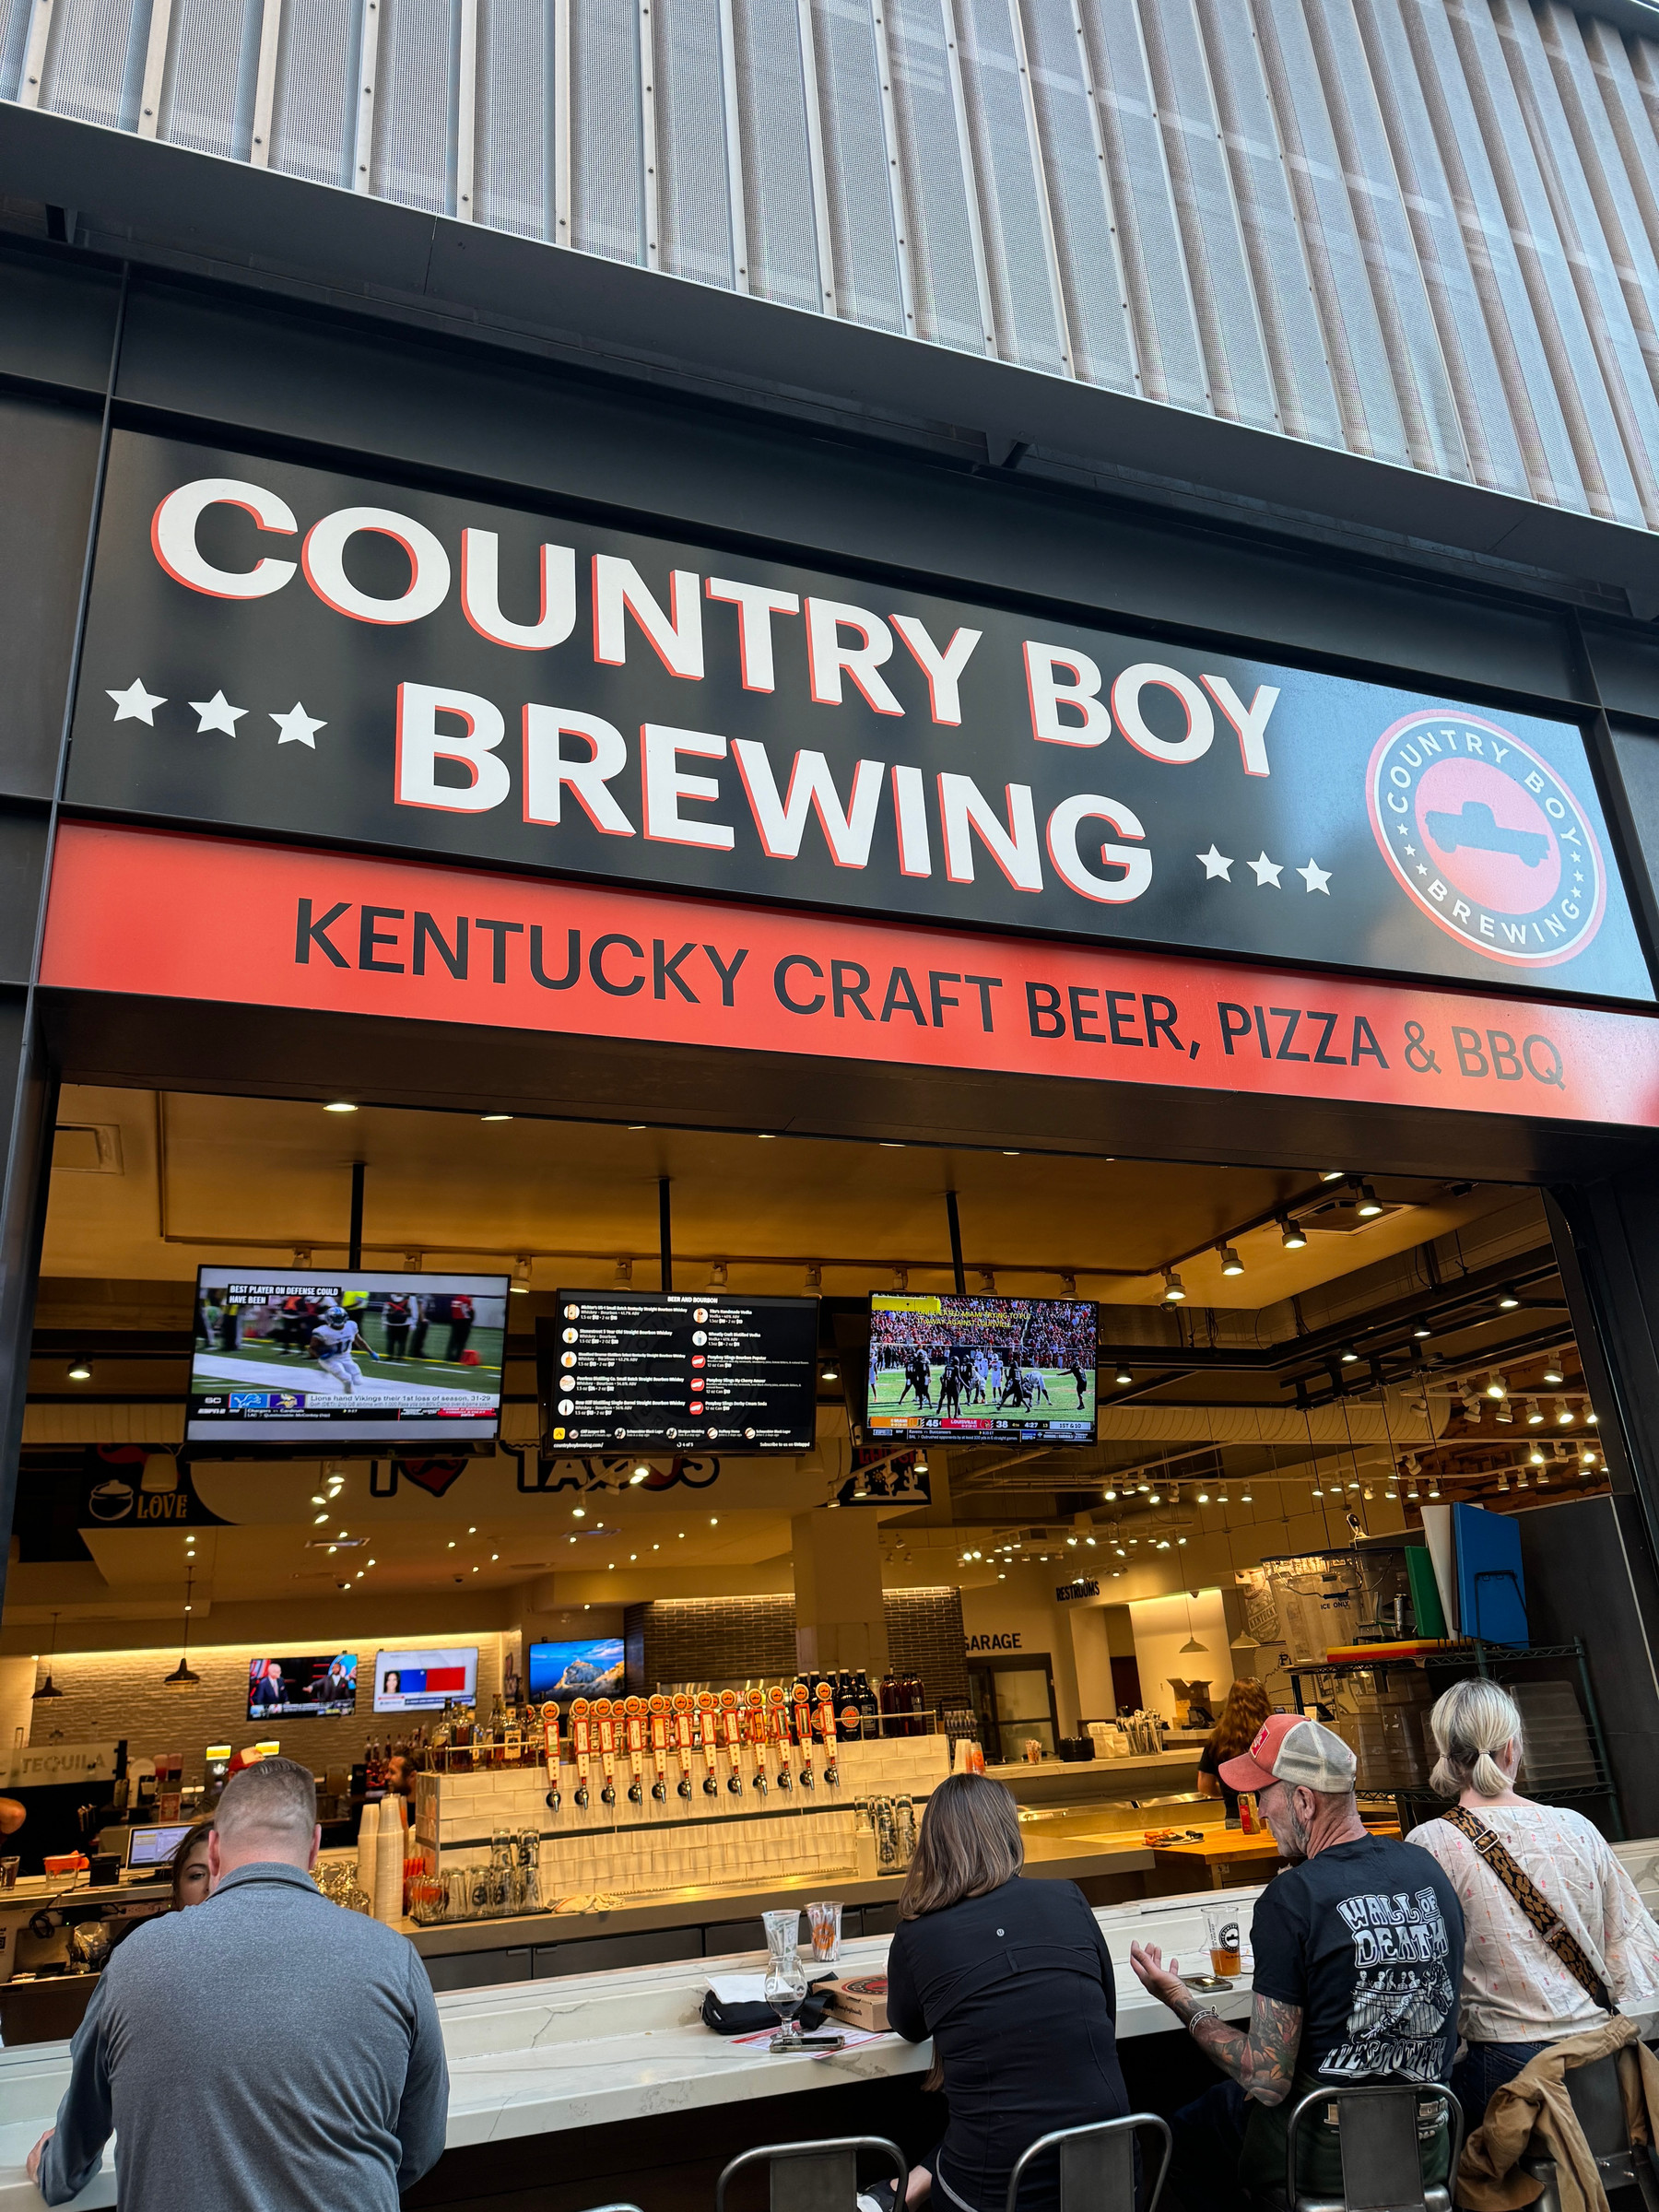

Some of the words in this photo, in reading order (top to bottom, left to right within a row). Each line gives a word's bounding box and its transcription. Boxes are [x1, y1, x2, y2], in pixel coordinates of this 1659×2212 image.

[151, 477, 982, 726] COUNTRY
[1022, 640, 1281, 778] BOY
[394, 681, 1154, 905] BREWING
[1387, 730, 1509, 813] COUNTRY
[1524, 771, 1582, 847] BOY
[1428, 879, 1580, 945] BREWING
[295, 897, 749, 1007] KENTUCKY
[772, 953, 1003, 1034] CRAFT
[1025, 981, 1202, 1061] BEER,
[1218, 1001, 1390, 1070] PIZZA
[1404, 1019, 1442, 1076] &
[1453, 1025, 1567, 1091] BBQ
[138, 1494, 187, 1519] LOVE
[1056, 1581, 1100, 1601] RESTROOMS
[22, 1753, 106, 1774] TEQUILA
[1336, 1893, 1420, 1932] WALL
[1352, 1916, 1449, 1969] DEATH
